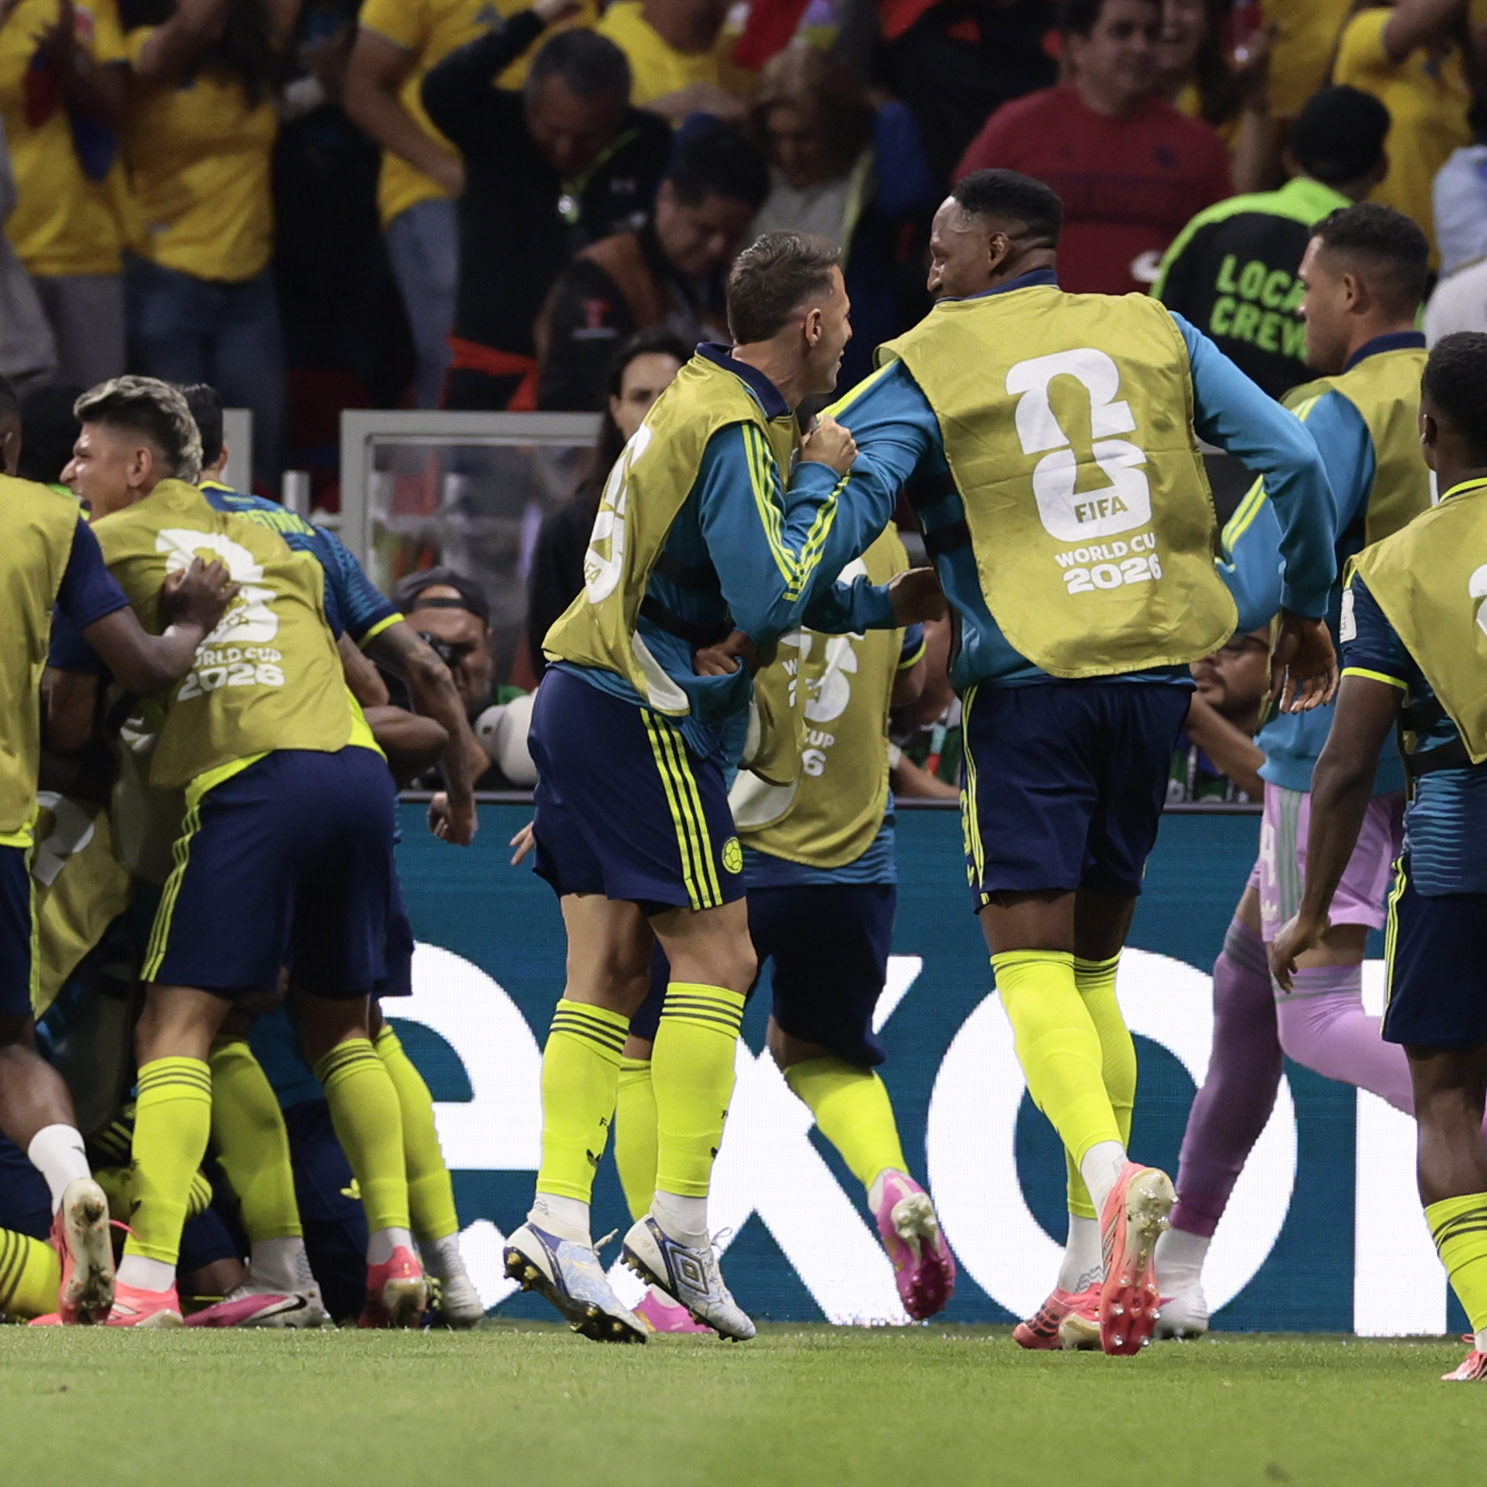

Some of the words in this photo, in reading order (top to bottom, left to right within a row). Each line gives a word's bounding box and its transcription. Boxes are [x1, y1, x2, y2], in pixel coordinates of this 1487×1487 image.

[1074, 496, 1129, 524] FIFA
[1054, 541, 1129, 569] WORLD
[1130, 532, 1157, 553] CU
[1063, 552, 1163, 596] 2026
[244, 646, 283, 663] CUP
[177, 662, 286, 702] 2026
